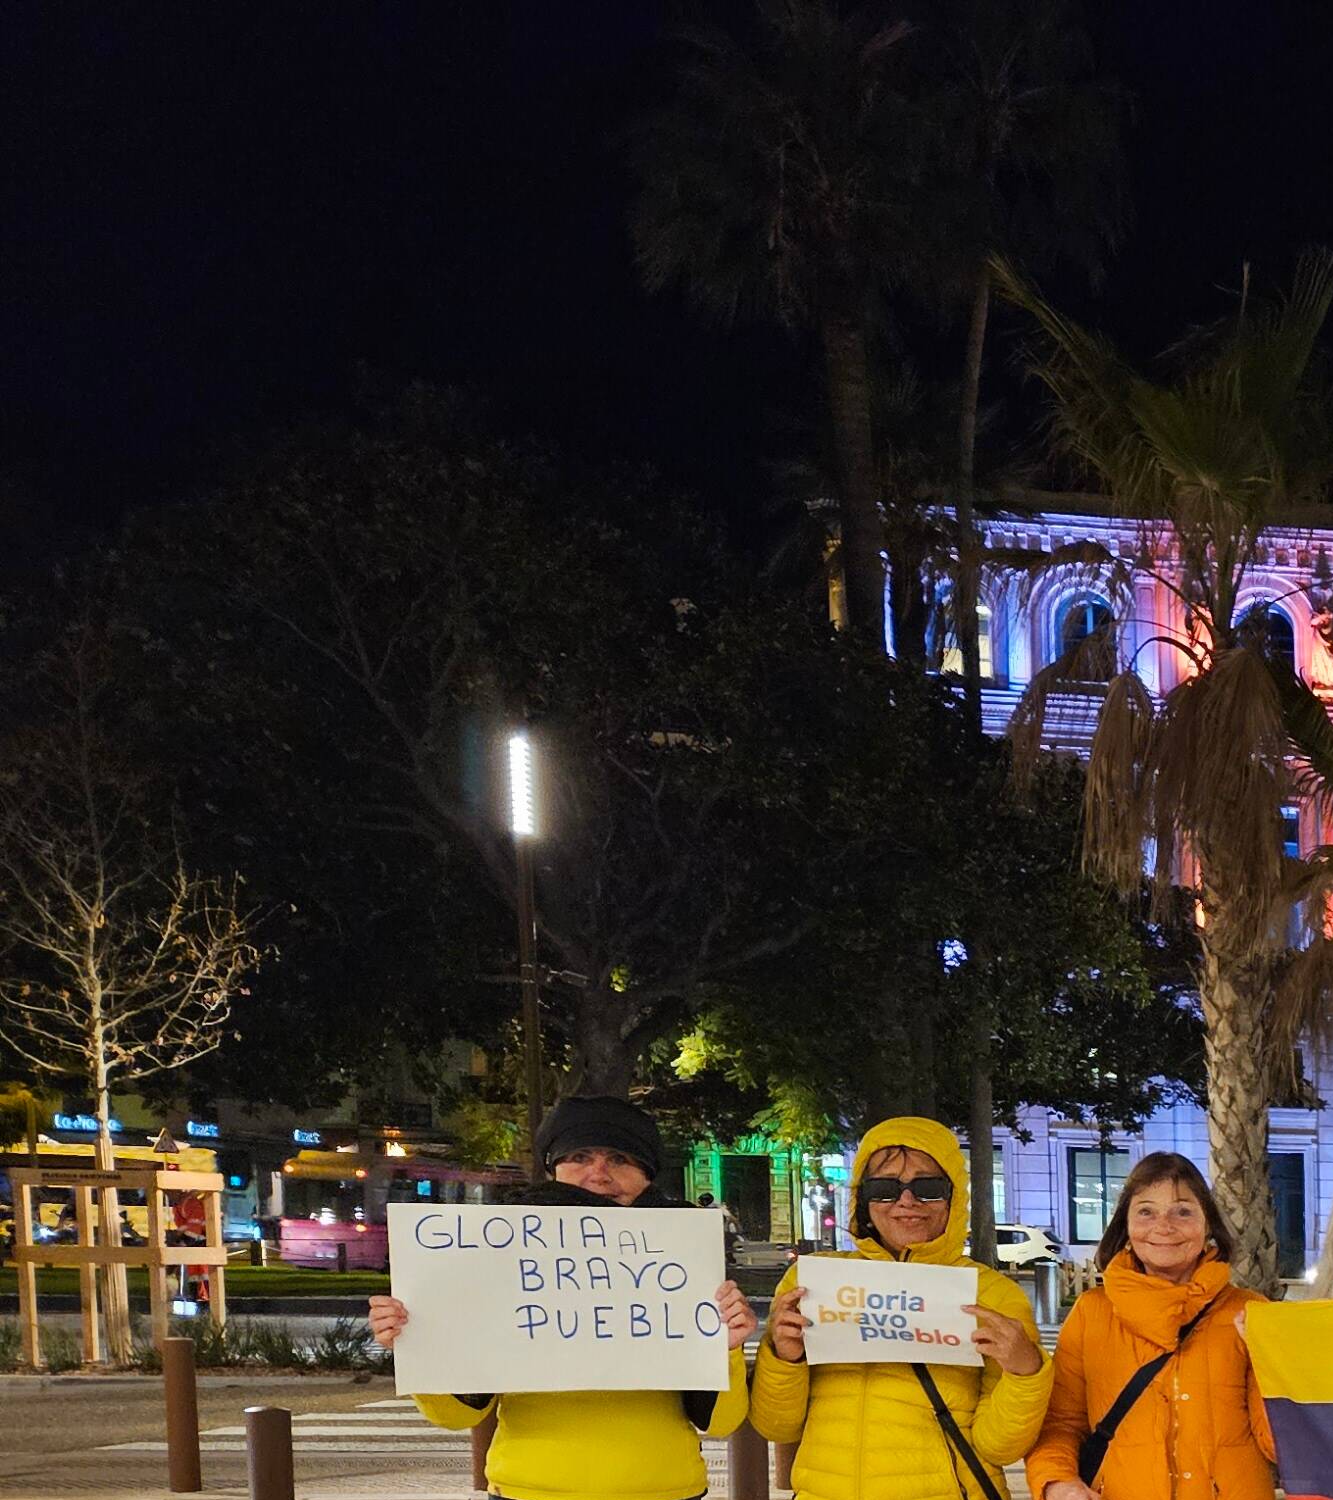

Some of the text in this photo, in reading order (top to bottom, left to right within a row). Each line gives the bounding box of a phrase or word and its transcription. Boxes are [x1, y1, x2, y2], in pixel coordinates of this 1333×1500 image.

[416, 1214, 664, 1254] GLORIA AL
[519, 1257, 687, 1292] BRAVO
[837, 1285, 925, 1312] Gloria
[515, 1301, 721, 1339] PUEBLO
[818, 1305, 907, 1328] bravo
[860, 1326, 961, 1346] pueblo
